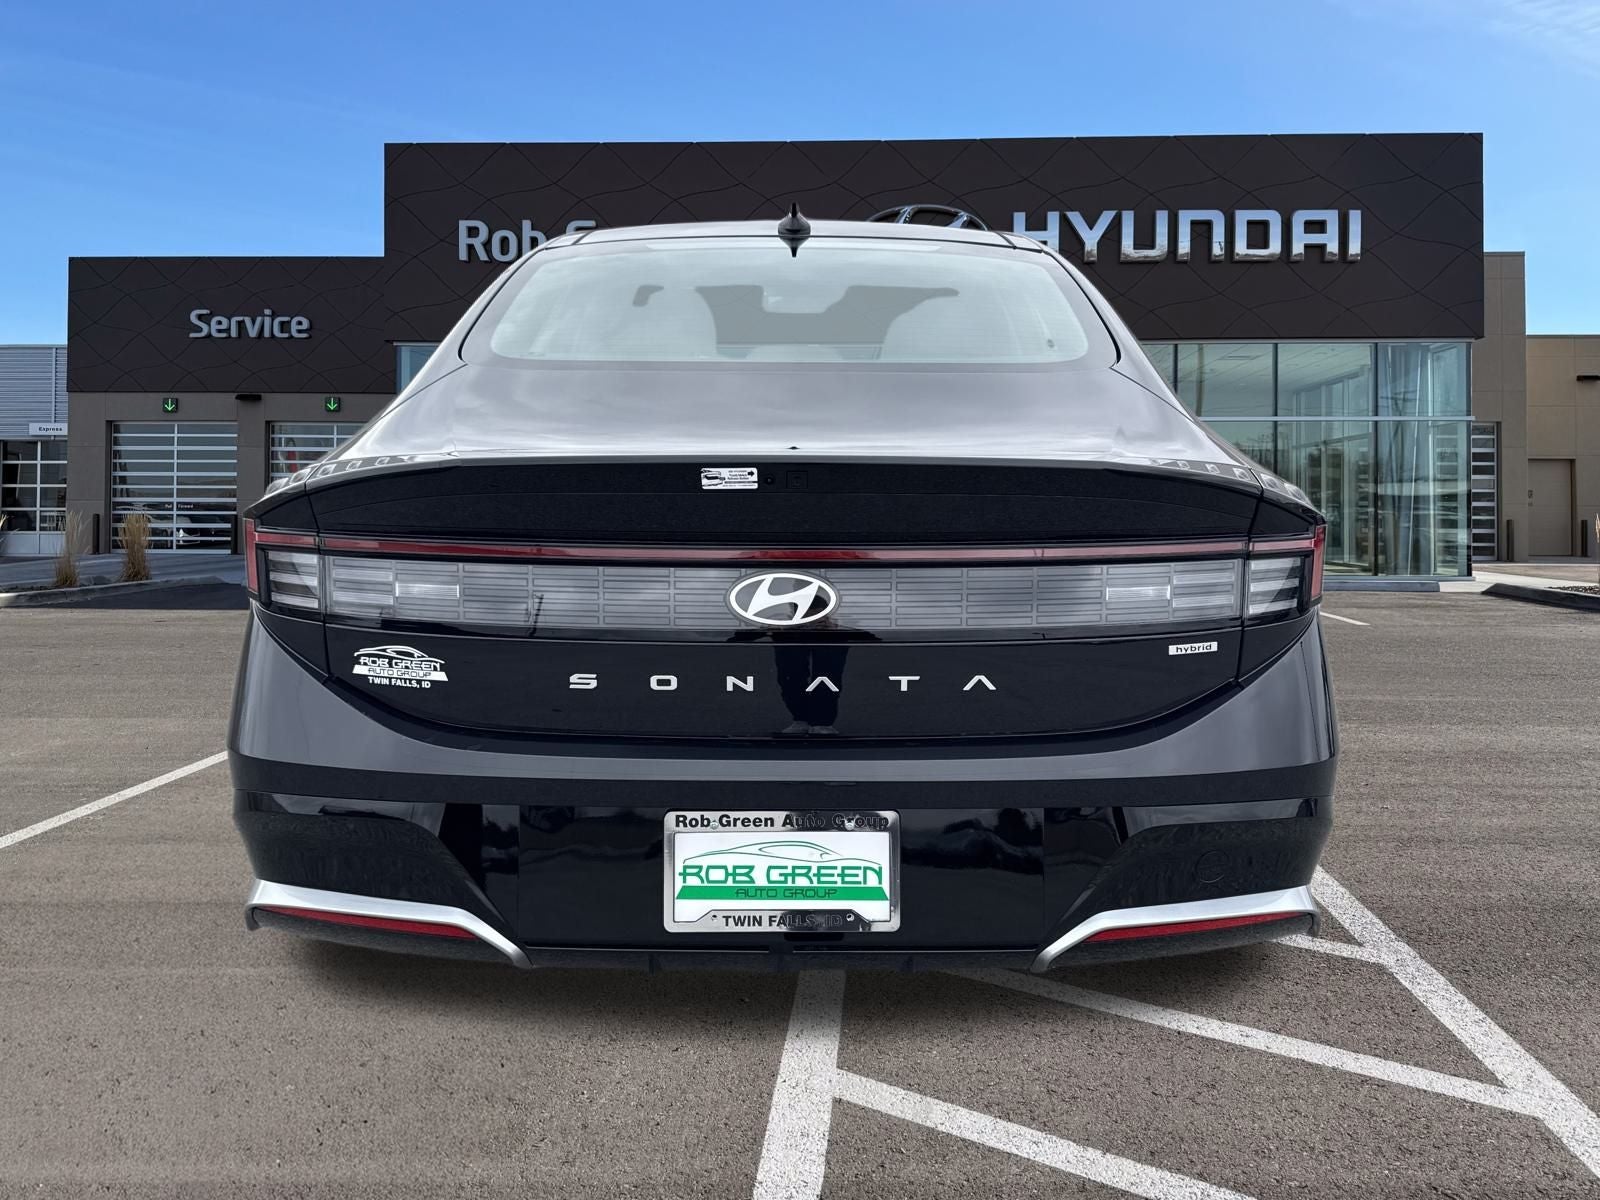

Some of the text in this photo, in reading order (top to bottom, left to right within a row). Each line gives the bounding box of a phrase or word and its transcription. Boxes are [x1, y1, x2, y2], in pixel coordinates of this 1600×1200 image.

[458, 219, 547, 262] Rob
[1013, 209, 1362, 263] HYUNDAI
[189, 309, 310, 338] Service
[1175, 643, 1212, 653] hybrid
[360, 656, 440, 671] ROB GREEN
[368, 667, 431, 678] AUTO GROUP
[368, 676, 431, 688] TWIN FALLS, ID
[569, 673, 996, 692] SONATA
[675, 814, 712, 828] Rob
[718, 814, 774, 828] Green
[781, 814, 825, 828] Auto
[678, 865, 883, 885] ROB GREEN
[735, 888, 838, 898] AUTO GROUP
[722, 915, 763, 927] TWIN
[824, 915, 842, 927] ID
